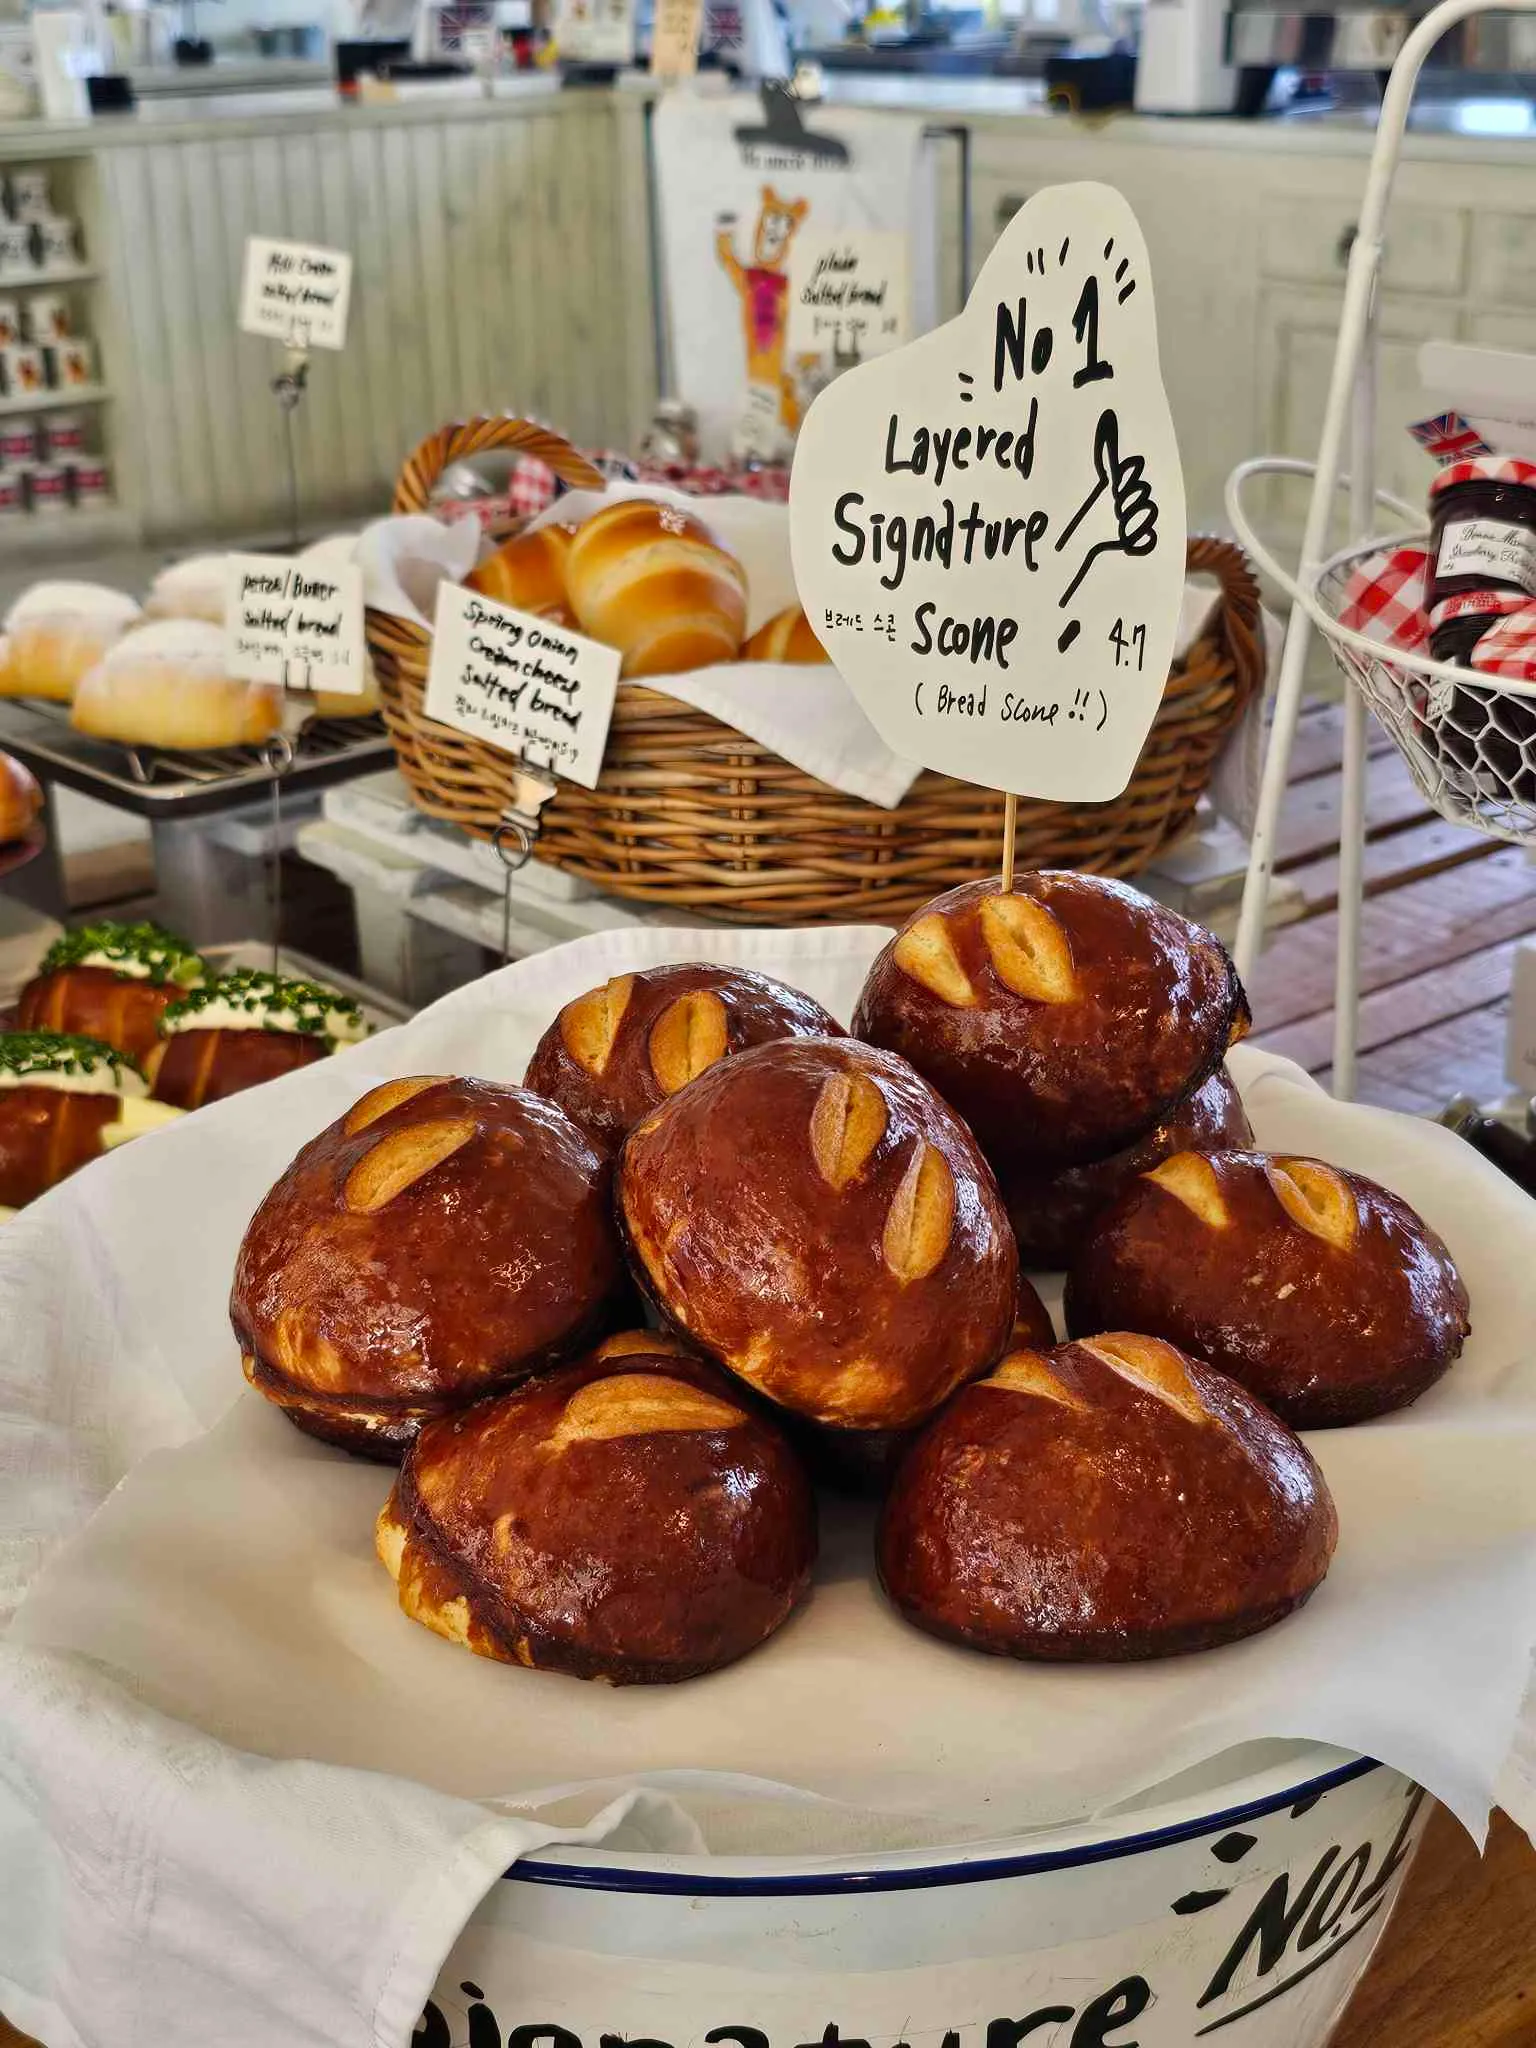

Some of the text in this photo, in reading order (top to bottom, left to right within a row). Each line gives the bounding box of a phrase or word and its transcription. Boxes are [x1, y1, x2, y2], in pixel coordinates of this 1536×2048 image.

[994, 275, 1114, 393] No 1
[884, 397, 1039, 487] Layered
[831, 492, 1050, 591] Signature
[463, 600, 580, 665] Spring Onion
[825, 608, 897, 642] 브레드 스콘
[910, 601, 1146, 671] Scone 4.7
